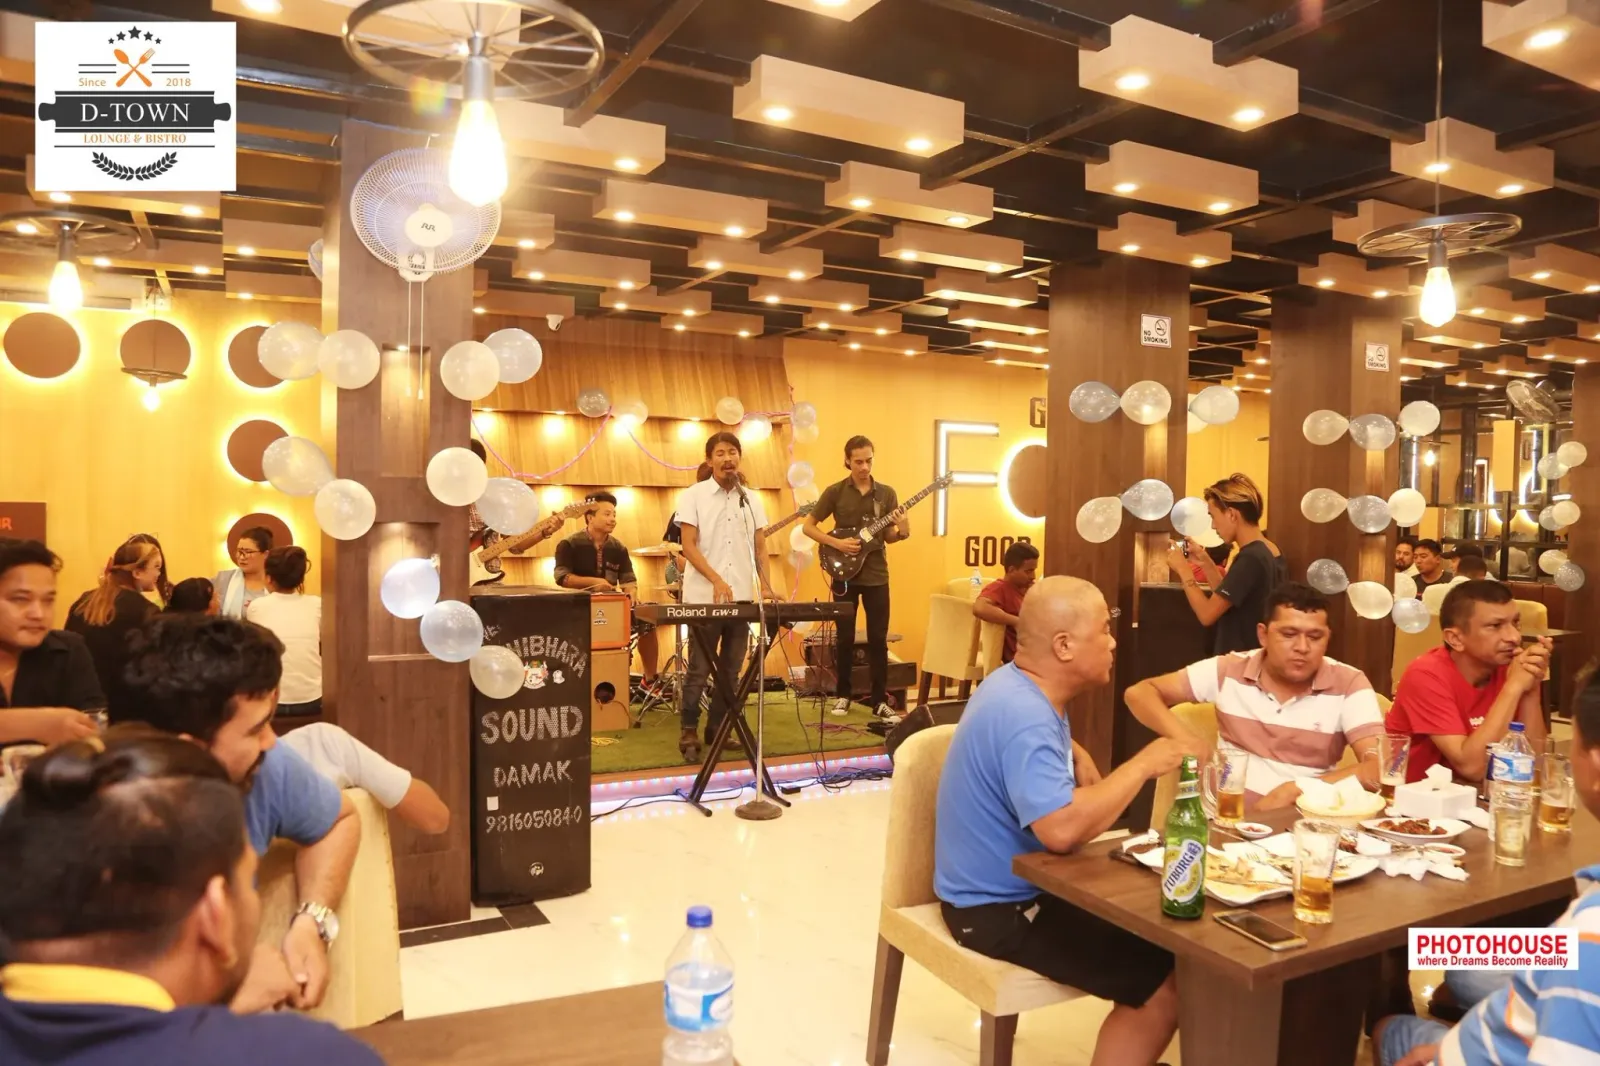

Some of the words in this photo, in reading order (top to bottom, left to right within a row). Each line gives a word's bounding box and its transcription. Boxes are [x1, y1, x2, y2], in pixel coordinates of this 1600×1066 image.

[1143, 336, 1168, 344] SMOKING
[965, 536, 1032, 568] GO
[667, 606, 707, 618] Roland
[712, 608, 739, 617] GW-8
[480, 705, 584, 745] SOUND
[493, 759, 574, 789] DAMAK
[1163, 850, 1196, 892] TUBORG
